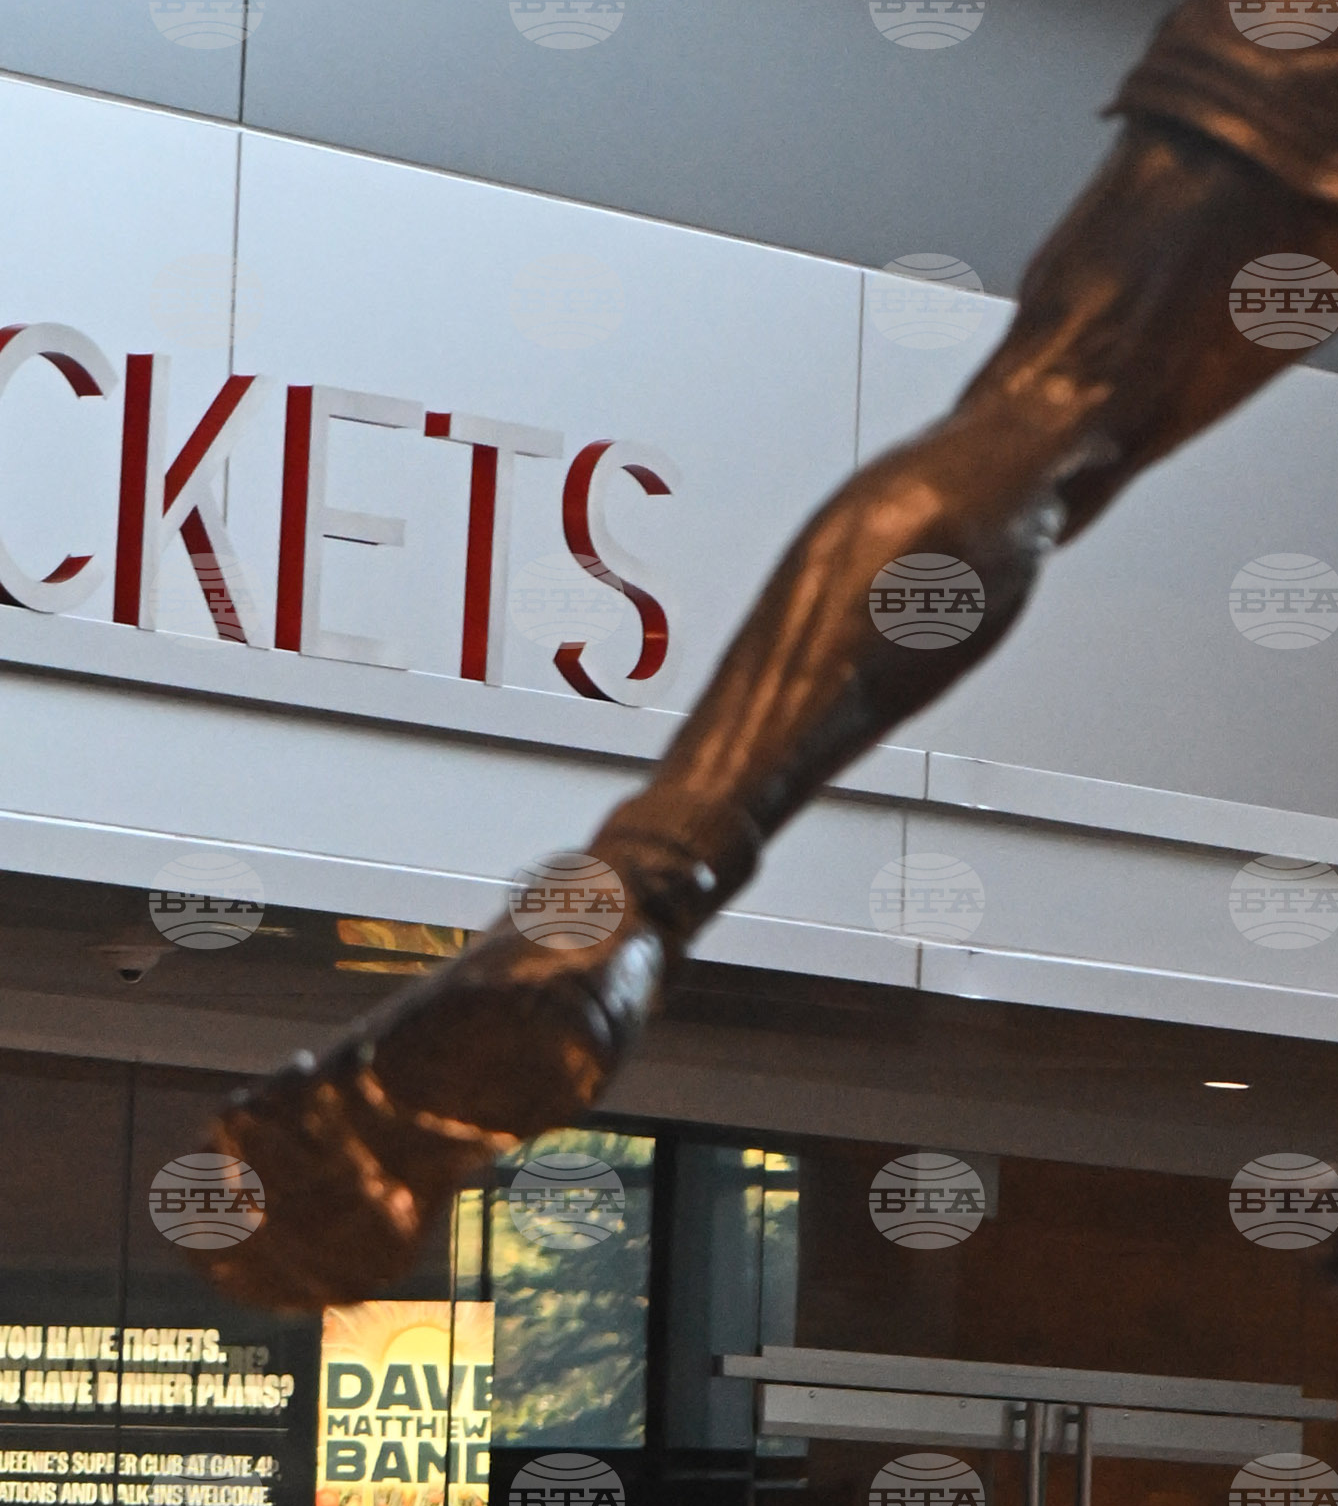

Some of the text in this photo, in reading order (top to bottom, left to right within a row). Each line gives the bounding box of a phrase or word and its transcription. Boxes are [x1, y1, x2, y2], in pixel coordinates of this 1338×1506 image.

[47, 1326, 118, 1361] HAVE
[122, 1328, 227, 1363] TICKETS.
[24, 1371, 93, 1405] HAVE
[197, 1373, 295, 1409] PLANS?
[327, 1362, 493, 1411] DAVE
[141, 1453, 184, 1477] CLUB
[187, 1455, 207, 1478] AT
[210, 1455, 252, 1478] GATE
[60, 1482, 98, 1505] AND
